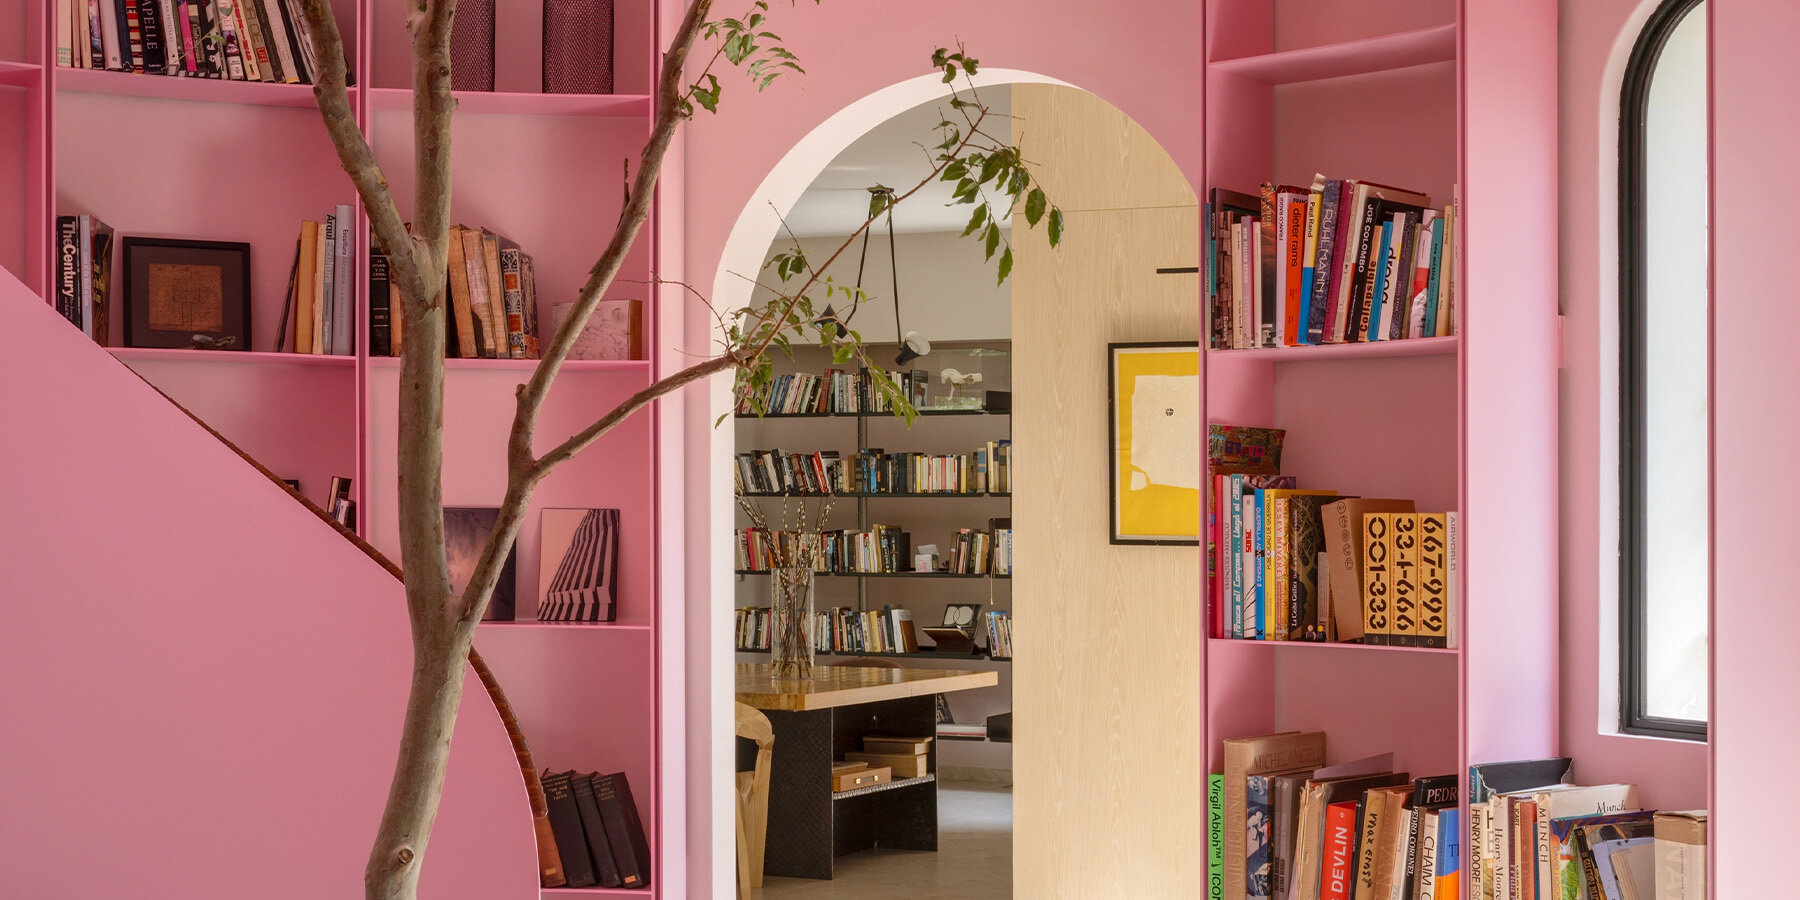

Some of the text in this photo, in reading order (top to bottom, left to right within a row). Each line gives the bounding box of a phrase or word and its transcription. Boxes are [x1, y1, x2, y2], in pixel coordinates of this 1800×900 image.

[257, 48, 268, 63] LIFE
[1292, 207, 1300, 239] dieter
[1308, 202, 1316, 217] Paul
[1291, 240, 1299, 267] rams
[1315, 208, 1333, 293] RUHLMANN
[1358, 225, 1370, 273] COLOMBO
[1360, 260, 1376, 332] Collapsible
[1266, 526, 1271, 534] DE
[1368, 516, 1387, 629] 001-333
[1395, 516, 1415, 631] 334-666
[1422, 516, 1443, 632] 667-999
[1253, 745, 1324, 771] MICHELANGELO
[1210, 779, 1221, 809] Virgil
[1427, 785, 1459, 803] PEDR
[1596, 799, 1626, 813] Munch
[1406, 805, 1419, 877] PEDRO CORONEL
[1472, 809, 1480, 845] HENRY
[1539, 807, 1548, 863] MUNCH
[1331, 826, 1348, 893] DEVLIN
[1422, 836, 1435, 886] CHAIM
[1472, 845, 1480, 883] MOORE
[1494, 828, 1503, 900] Henry Moore
